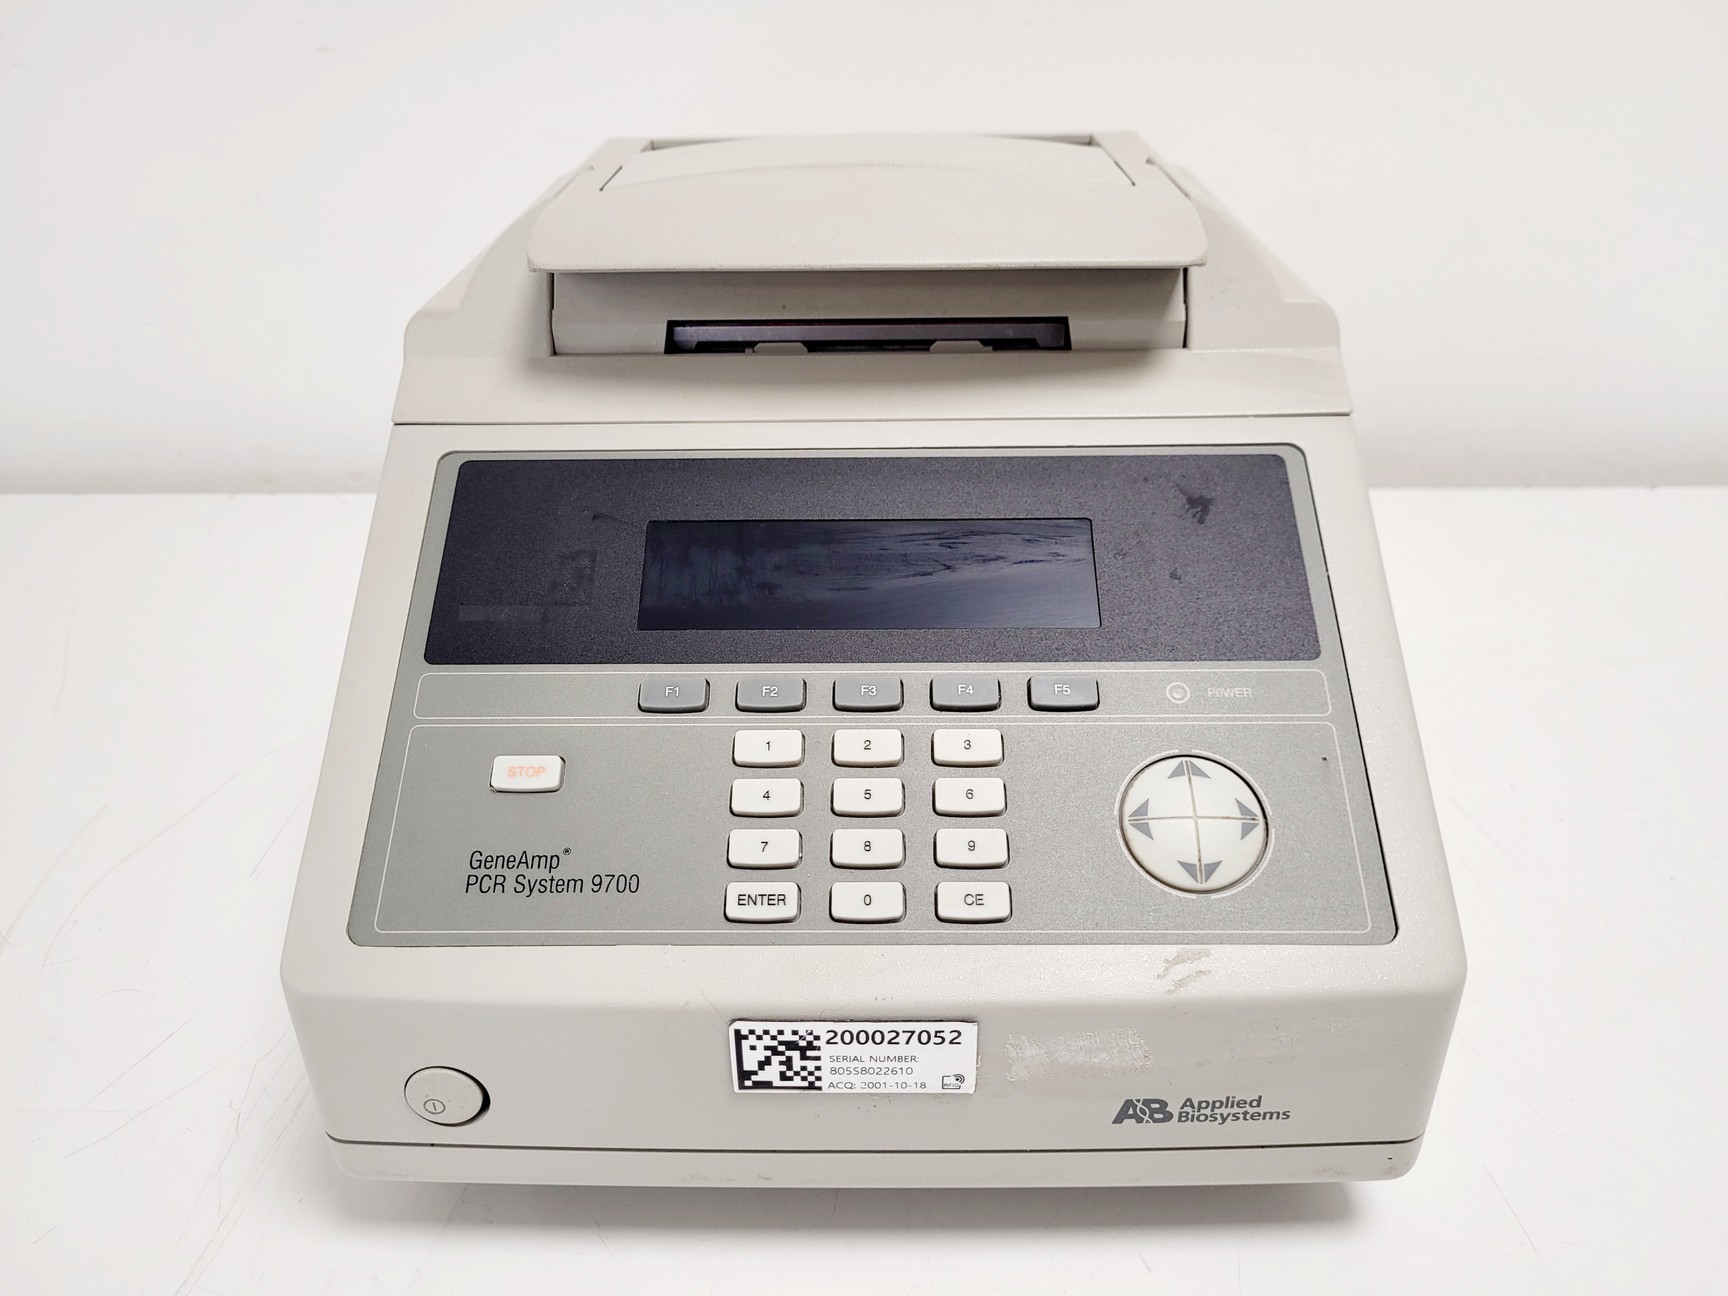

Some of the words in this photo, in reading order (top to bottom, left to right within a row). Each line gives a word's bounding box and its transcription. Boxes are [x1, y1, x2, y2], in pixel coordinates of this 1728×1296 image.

[665, 686, 680, 697] F1
[762, 686, 779, 697] F2
[860, 685, 877, 696] F3
[957, 685, 974, 695] F4
[1054, 684, 1071, 695] F5
[1207, 687, 1252, 698] POWER
[864, 740, 872, 750] 2
[963, 740, 971, 750] 3
[507, 766, 546, 778] STOP
[762, 790, 770, 800] 4
[864, 789, 872, 800] 5
[966, 789, 974, 799] 6
[760, 842, 769, 852] 7
[864, 841, 872, 852] 8
[968, 840, 976, 851] 9
[465, 873, 507, 894] PCR
[513, 873, 584, 898] System
[591, 873, 640, 894] 9700
[737, 894, 786, 906] ENTER
[863, 894, 872, 906] 0
[963, 893, 985, 906] CE
[825, 1029, 963, 1046] 200027052
[829, 1054, 866, 1063] SERIAL
[869, 1054, 919, 1063] NUMBER:
[828, 1081, 856, 1091] ACQ:
[860, 1081, 927, 1090] 2001-10-18
[1179, 1094, 1263, 1113] Applied
[1177, 1108, 1291, 1126] Biosystems
